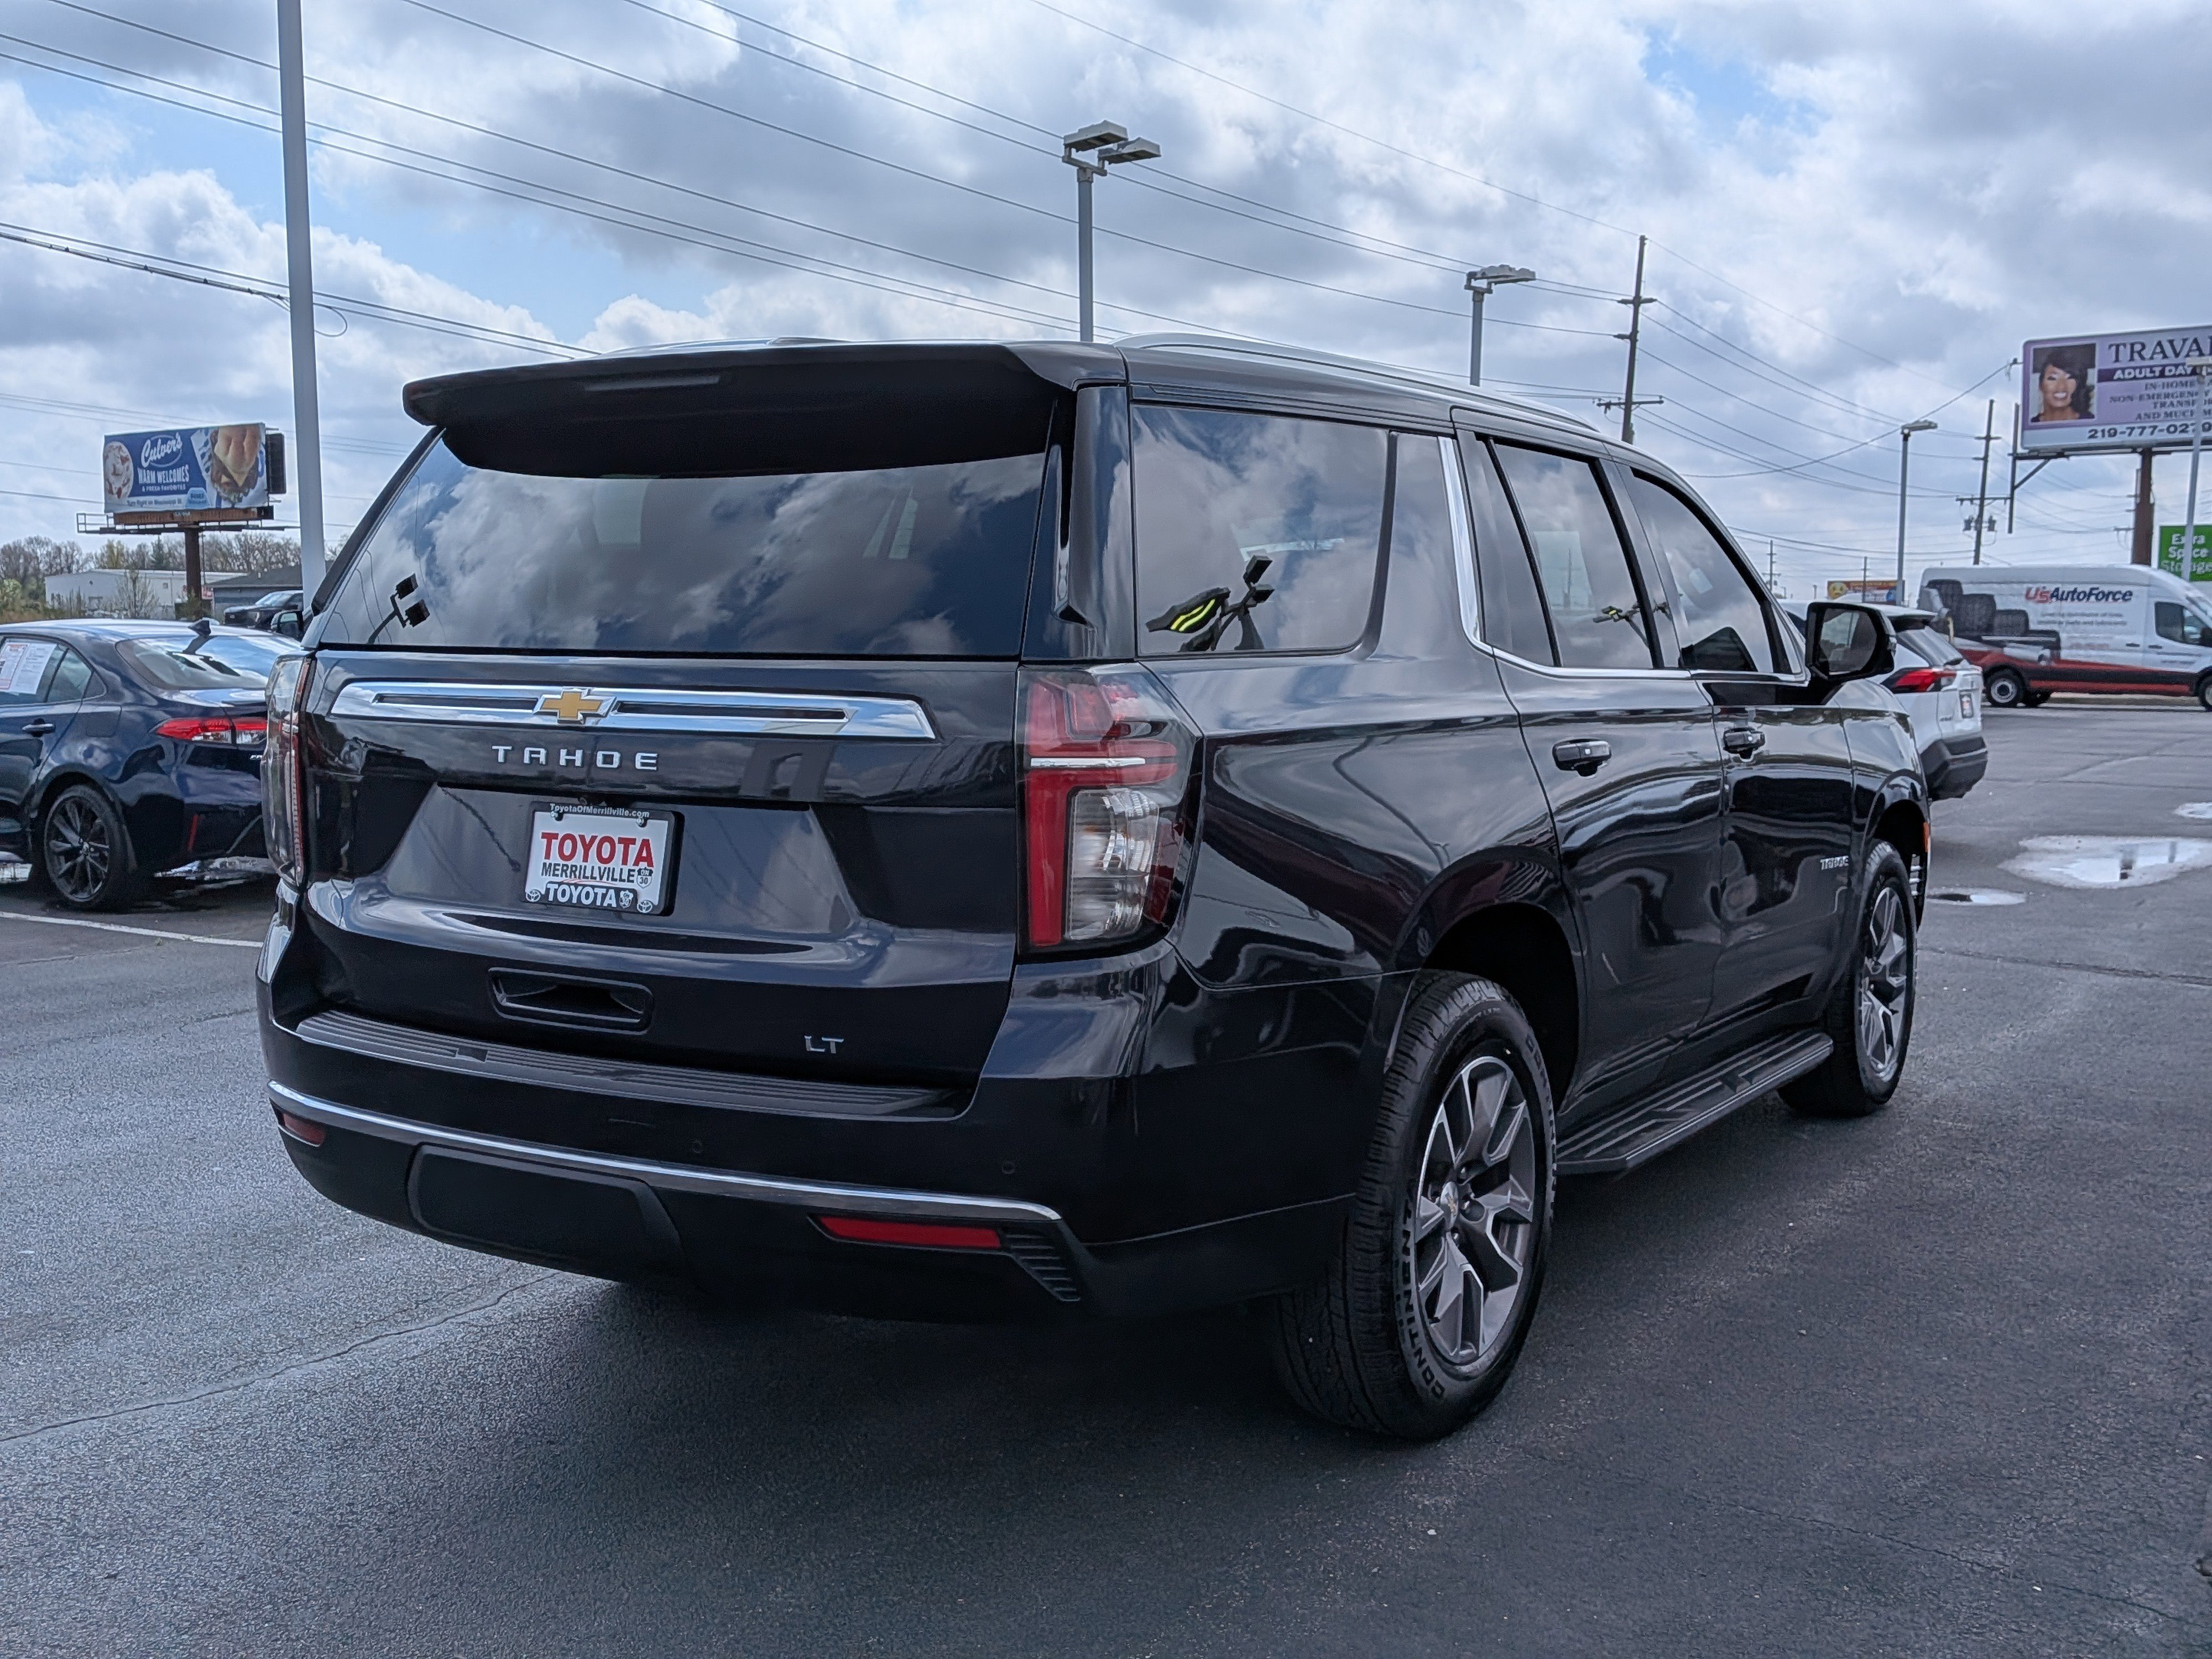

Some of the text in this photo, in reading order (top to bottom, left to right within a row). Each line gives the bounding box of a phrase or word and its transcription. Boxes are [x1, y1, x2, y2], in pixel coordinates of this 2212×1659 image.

[2108, 335, 2212, 363] TRAVA
[2114, 367, 2162, 380] ADULT
[137, 464, 189, 484] WARM WELCOMES
[2172, 533, 2205, 545] Era
[2168, 546, 2208, 560] Spce
[2161, 560, 2212, 575] Stoge
[492, 745, 658, 771] TAHOE
[541, 832, 654, 868] TOYOTA
[541, 862, 636, 884] MERRILLVILLE
[546, 884, 617, 907] TOYOTA
[804, 1035, 844, 1054] LT
